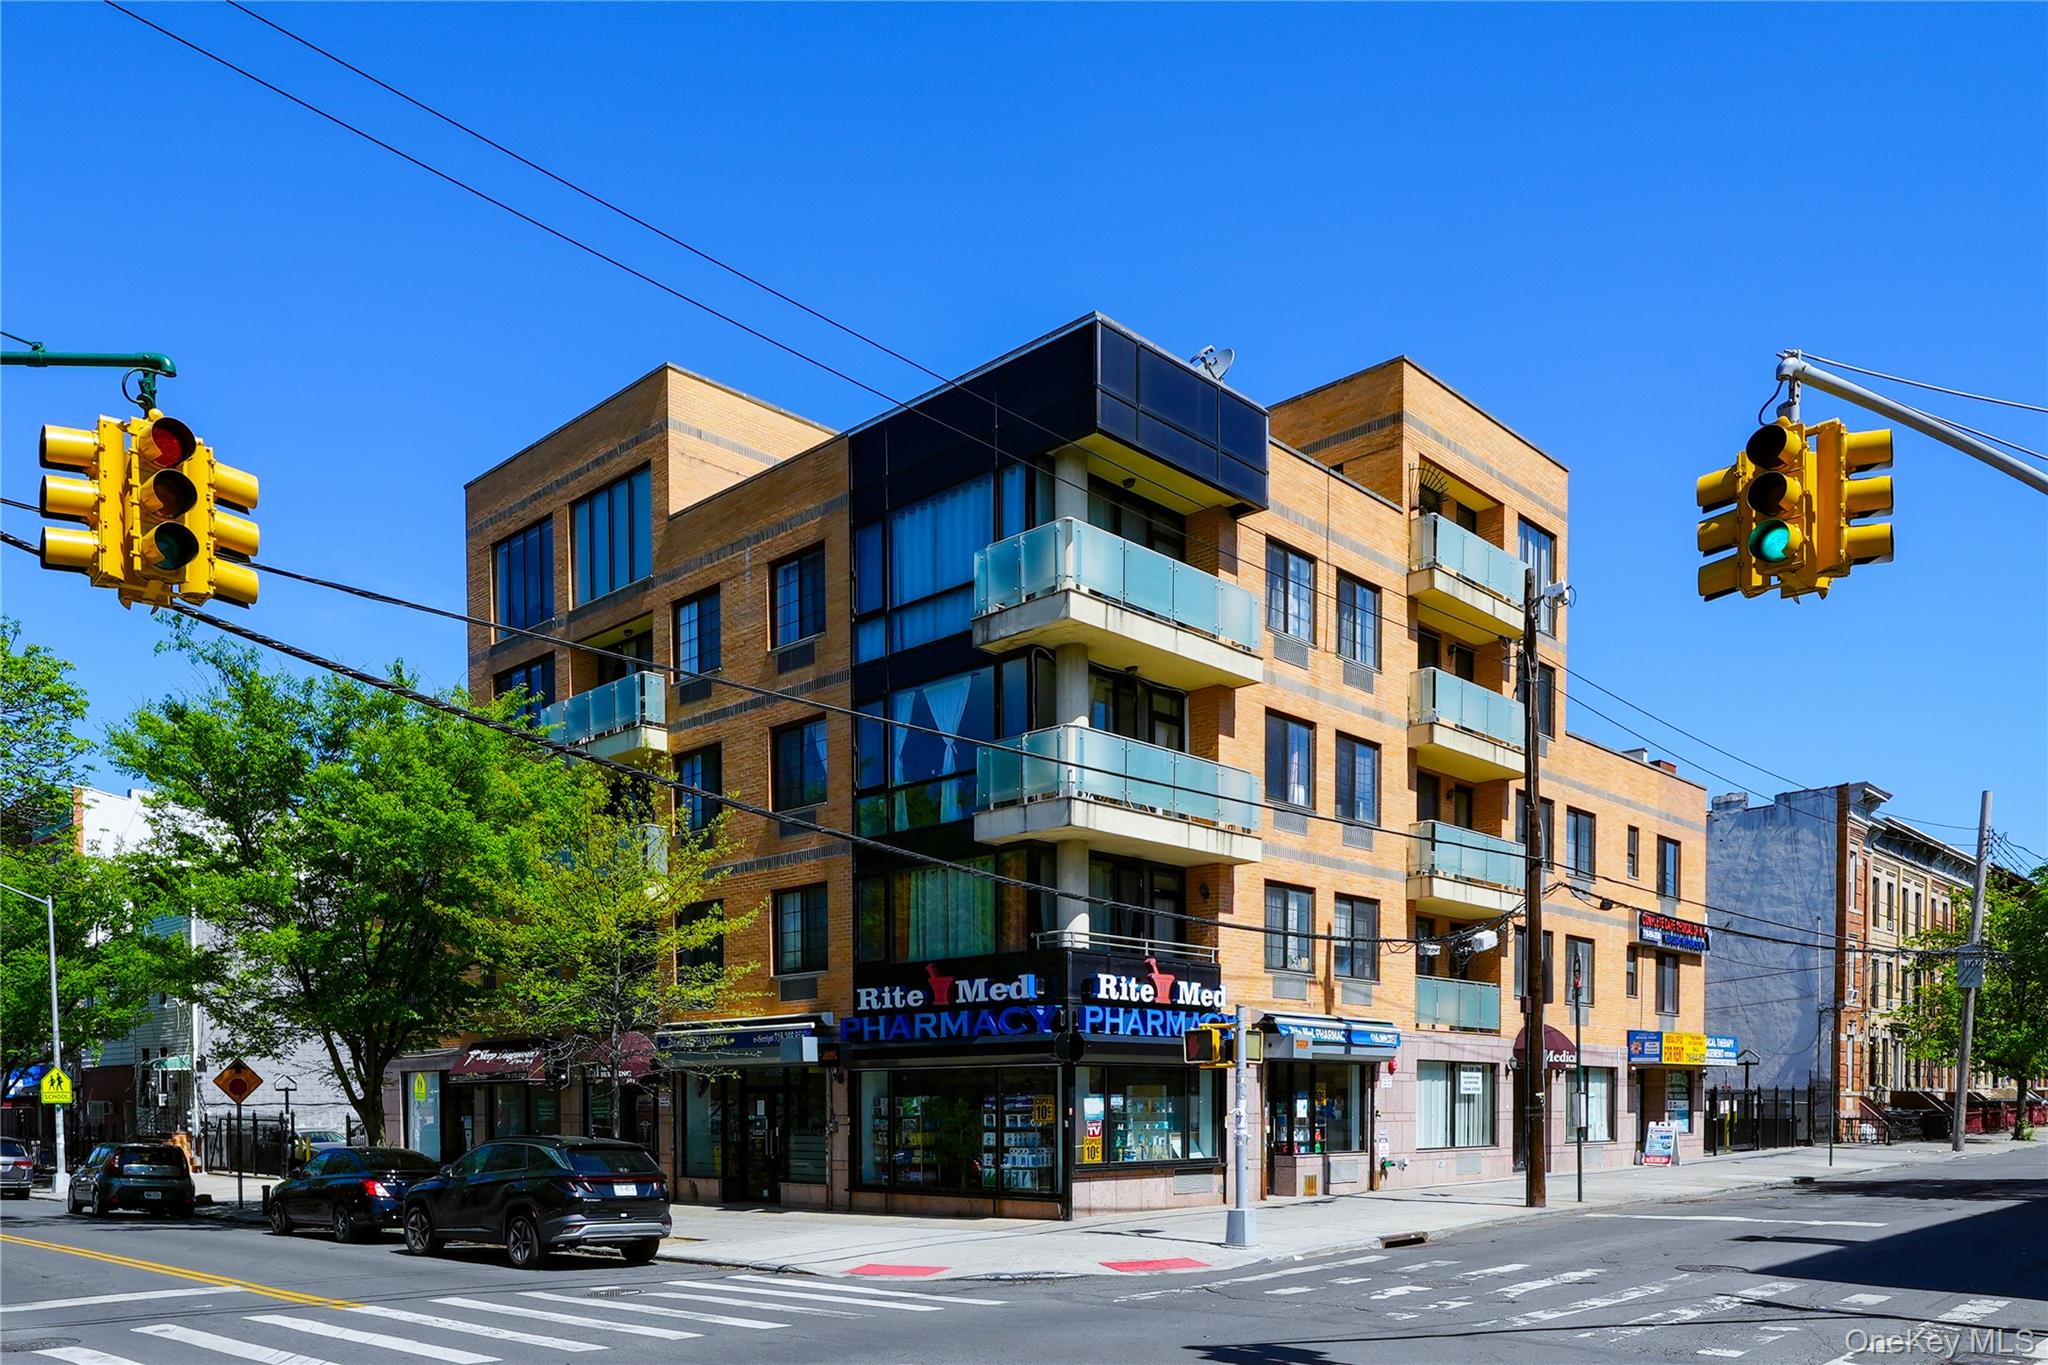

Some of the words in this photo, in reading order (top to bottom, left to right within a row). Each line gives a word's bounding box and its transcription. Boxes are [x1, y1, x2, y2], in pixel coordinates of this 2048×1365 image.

[856, 985, 924, 1010] Rite
[955, 974, 1037, 1003] Med
[1097, 973, 1155, 1003] Rite
[1177, 980, 1227, 1008] Med
[840, 1005, 1062, 1042] PHARMACY
[1088, 1126, 1101, 1136] TV
